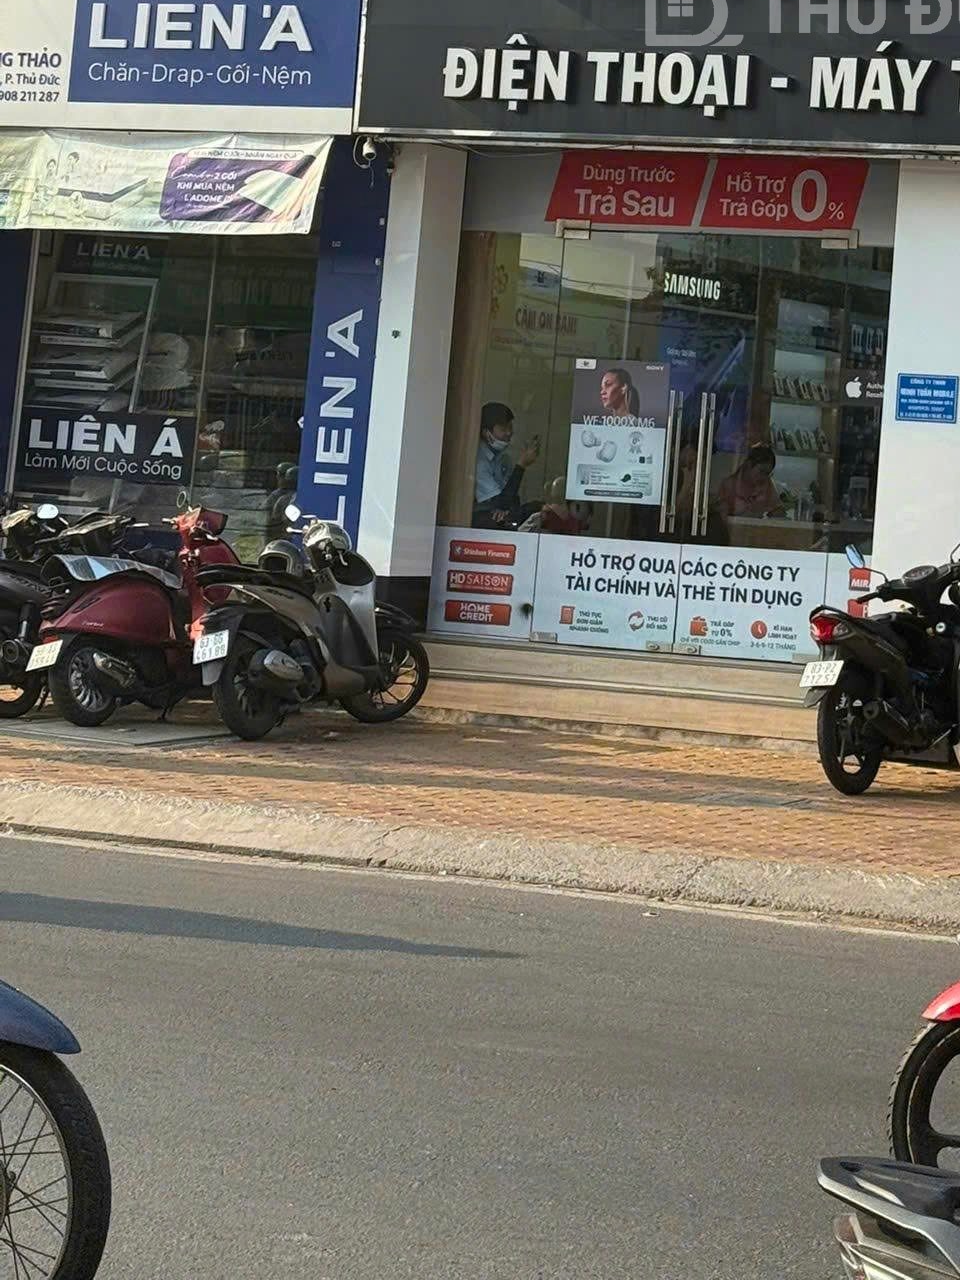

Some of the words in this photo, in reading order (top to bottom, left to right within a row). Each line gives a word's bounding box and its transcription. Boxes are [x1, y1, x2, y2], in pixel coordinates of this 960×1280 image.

[17, 47, 62, 68] THẢO
[16, 72, 36, 85] Thủ
[39, 73, 61, 86] Đức
[443, 33, 570, 112] ĐIỆN
[587, 51, 750, 118] THOẠI
[809, 40, 933, 112] MÁY
[20, 91, 36, 102] 211
[39, 91, 60, 102] 287
[583, 164, 624, 184] Dùng
[628, 164, 676, 183] Trước
[726, 170, 751, 192] Hỗ
[756, 174, 786, 198] Trợ
[574, 186, 617, 216] Trả
[622, 189, 675, 218] Sau
[719, 197, 748, 217] Trả
[752, 196, 788, 221] Góp
[664, 271, 721, 300] SAMSUNG
[27, 414, 138, 456] LIÊN
[150, 418, 184, 459] Á
[24, 452, 57, 469] Làm
[61, 454, 90, 471] Mới
[94, 457, 138, 476] Cuộc
[142, 459, 182, 480] Sống
[570, 548, 596, 568] HỖ
[600, 554, 636, 574] TRỢ
[639, 557, 676, 574] QUA
[681, 557, 718, 577] CÁC
[721, 560, 773, 581] CÔNG
[777, 566, 801, 582] TY
[565, 572, 591, 592] TÀI
[594, 575, 650, 597] CHÍNH
[654, 579, 676, 598] VÀ
[719, 583, 747, 603] TÍN
[751, 588, 803, 610] DỤNG
[459, 611, 494, 623] CREDIT
